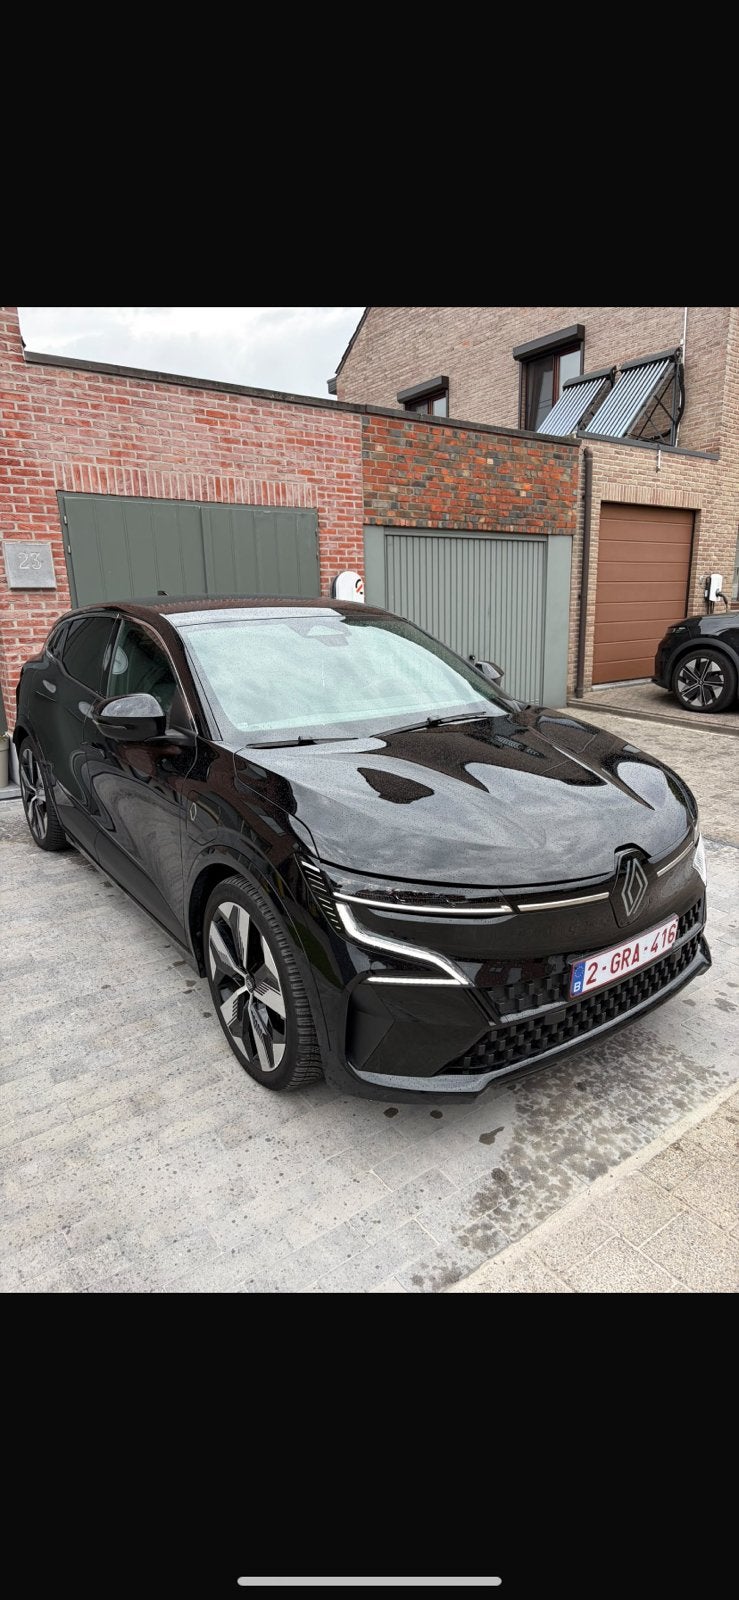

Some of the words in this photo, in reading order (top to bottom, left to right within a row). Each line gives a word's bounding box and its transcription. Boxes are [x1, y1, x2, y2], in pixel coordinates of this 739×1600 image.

[17, 551, 42, 570] 23
[585, 923, 677, 986] 2-GRA-416
[573, 981, 581, 993] B
